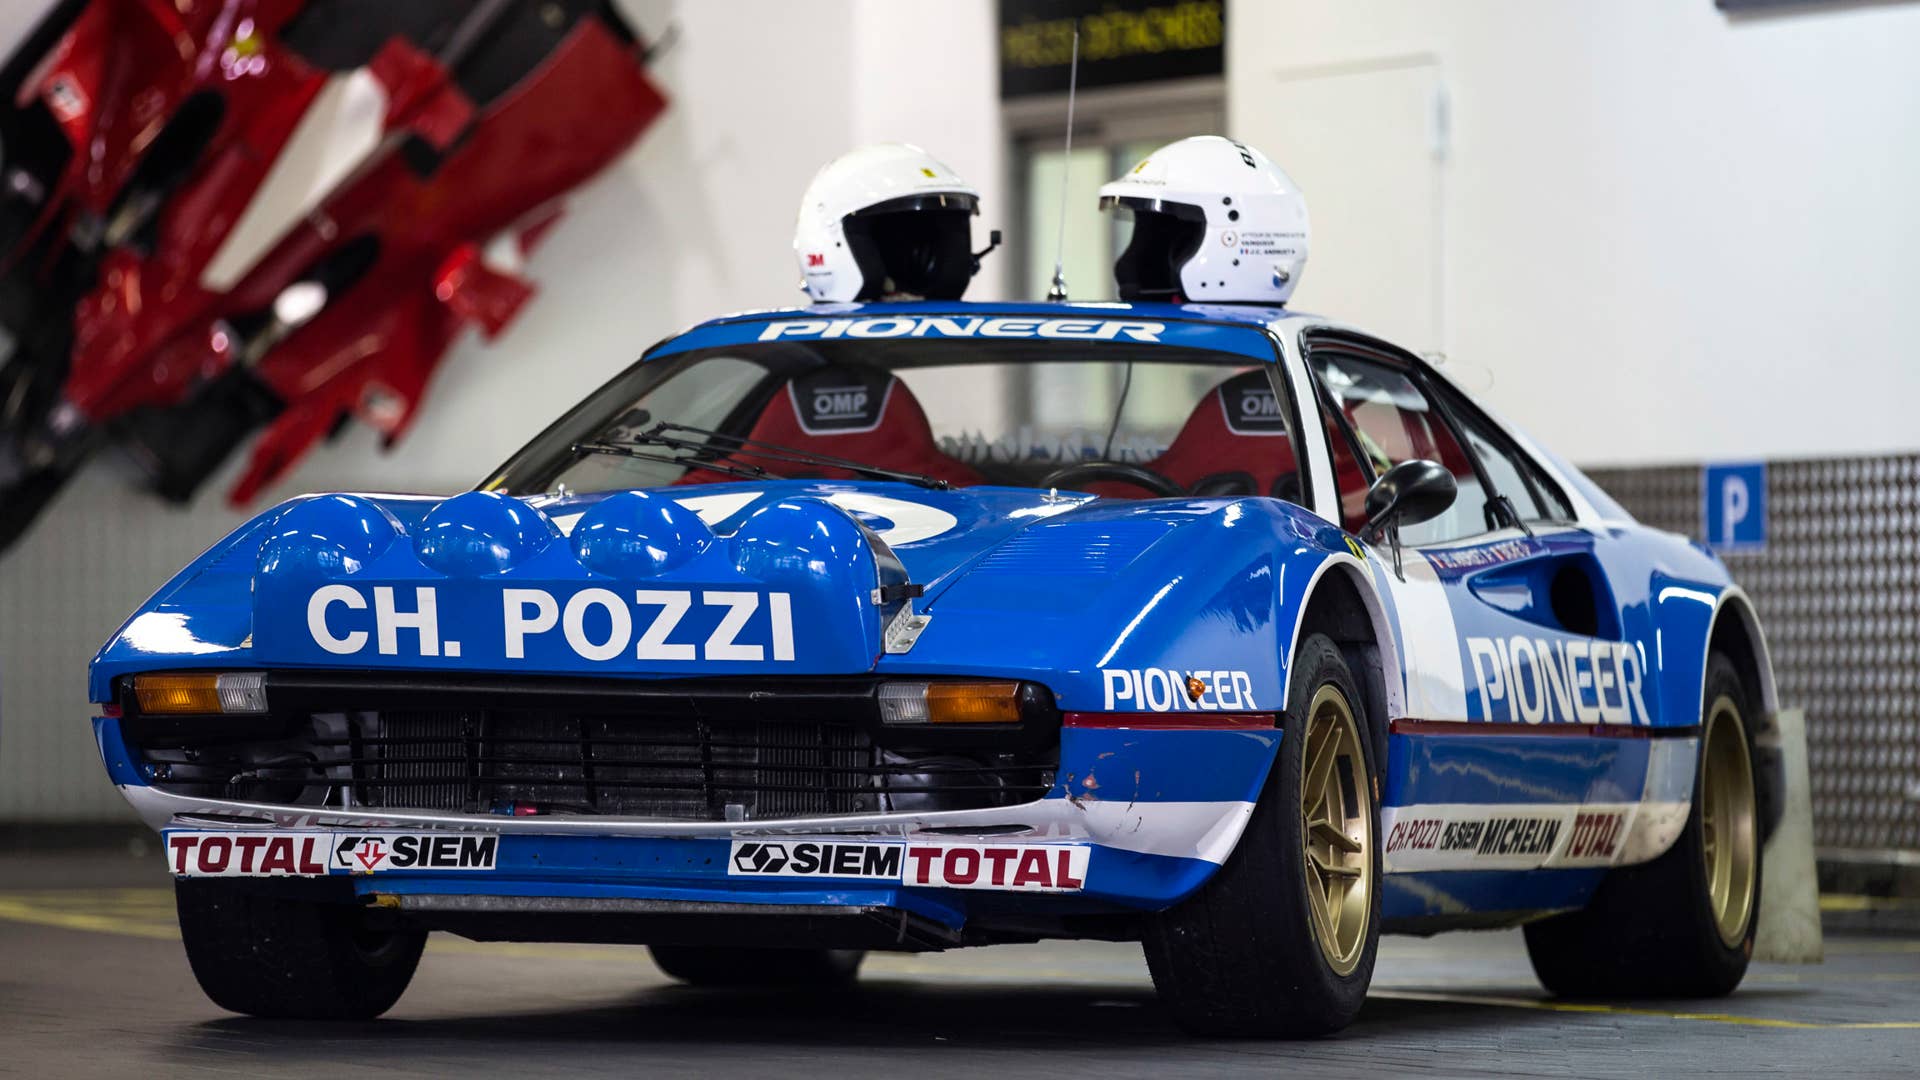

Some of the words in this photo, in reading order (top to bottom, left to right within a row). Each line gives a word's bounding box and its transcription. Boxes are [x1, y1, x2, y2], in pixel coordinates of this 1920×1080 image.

[807, 254, 825, 267] 3M
[757, 317, 1167, 342] PIONEER
[814, 393, 867, 414] OMP
[1241, 395, 1281, 415] OM
[1722, 475, 1749, 546] P
[307, 584, 461, 658] CH.
[503, 588, 796, 661] POZZI
[1102, 667, 1258, 712] PIONEER
[1466, 635, 1651, 725] PIONEER
[170, 836, 325, 875] TOTAL
[390, 836, 488, 868] SIEM
[1453, 821, 1486, 851] SIEM
[1478, 818, 1562, 855] MICHELIN
[1566, 814, 1623, 857] TOTAL
[790, 842, 900, 876] SIEM
[909, 847, 1083, 889] TOTAL
